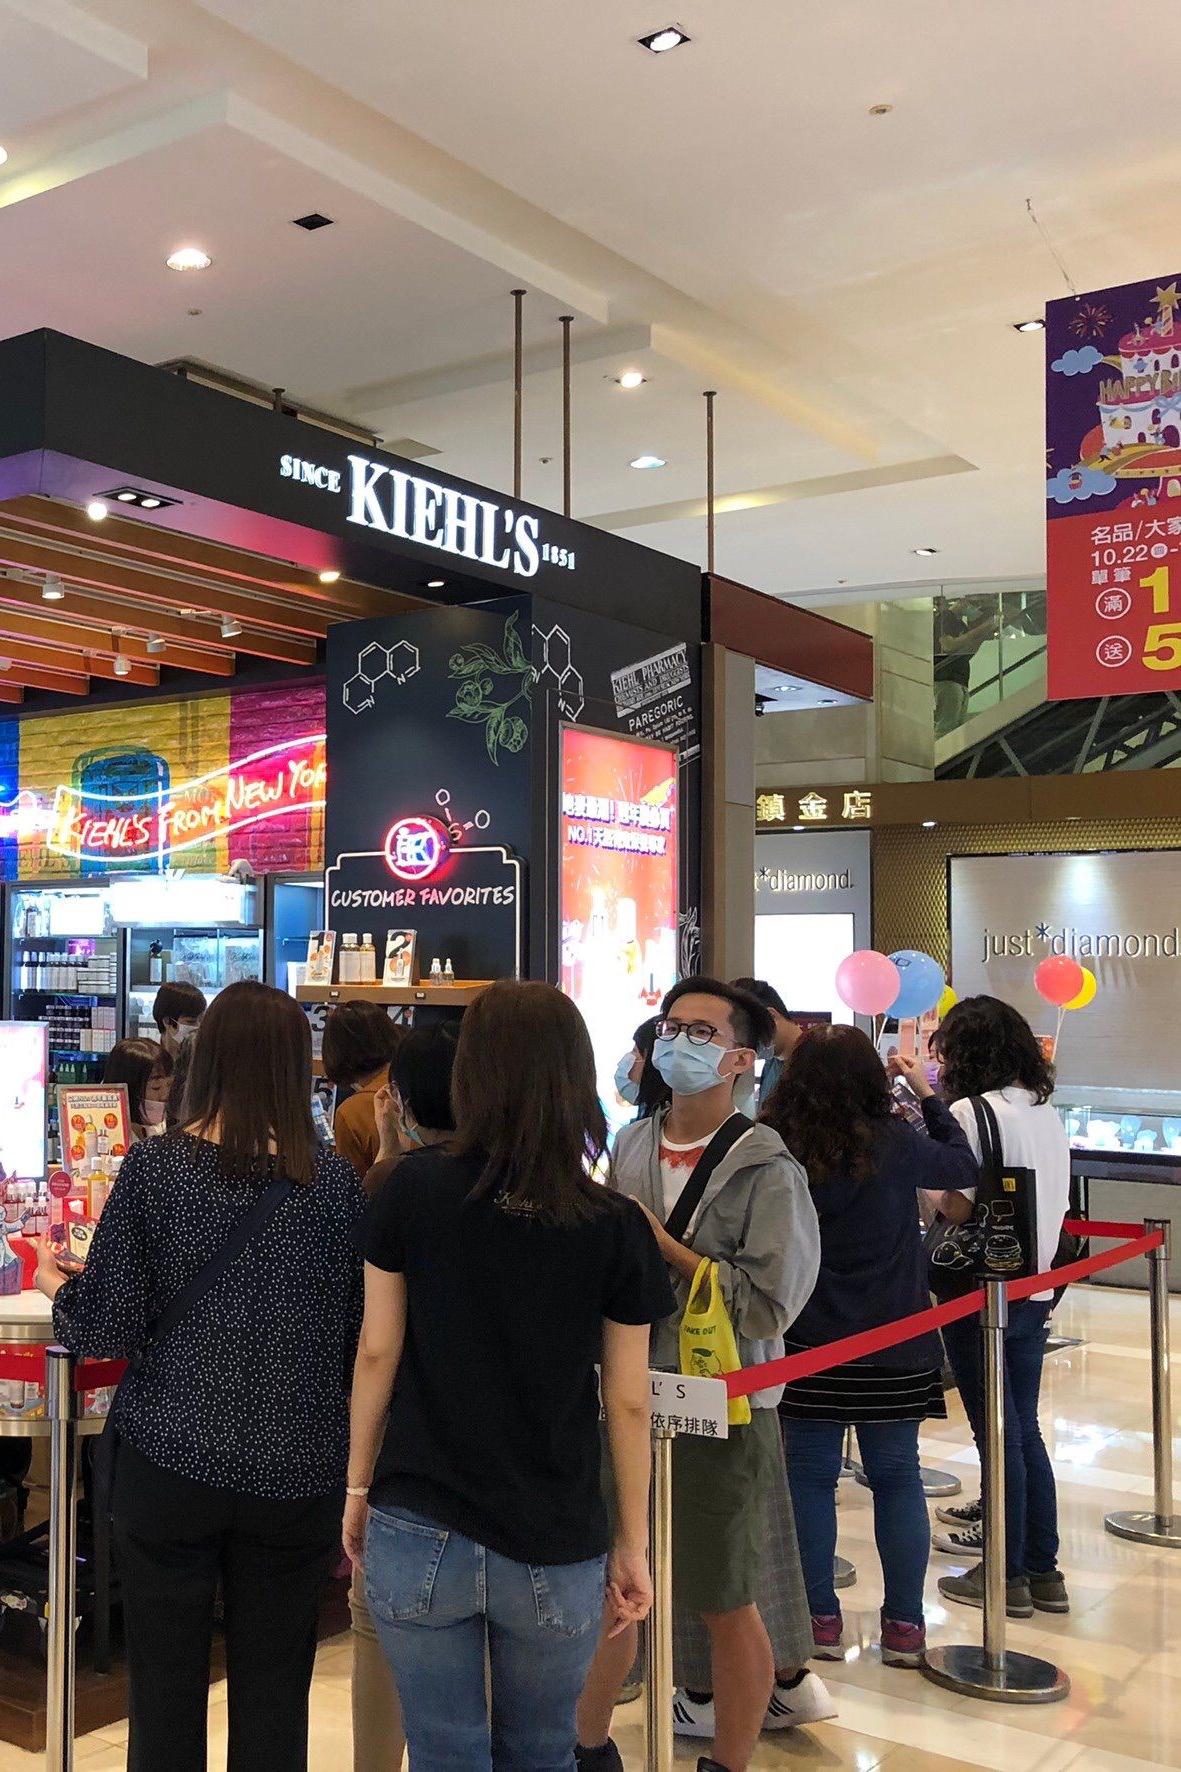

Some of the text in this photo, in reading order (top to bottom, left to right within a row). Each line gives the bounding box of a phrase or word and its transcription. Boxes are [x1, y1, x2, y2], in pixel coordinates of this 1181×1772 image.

[1099, 373, 1160, 404] HAPPY
[280, 454, 576, 578] SINCE KIEHL'S 1851
[641, 650, 688, 681] PHARMACY
[628, 695, 685, 732] PAREGORIC
[58, 804, 153, 849] KIEHL'S
[158, 801, 221, 846] FROM
[224, 771, 284, 818] NEW
[331, 885, 515, 909] CUSTOMER FAVORITES
[702, 1325, 717, 1335] OUT
[651, 1411, 719, 1437] 依序排隊
